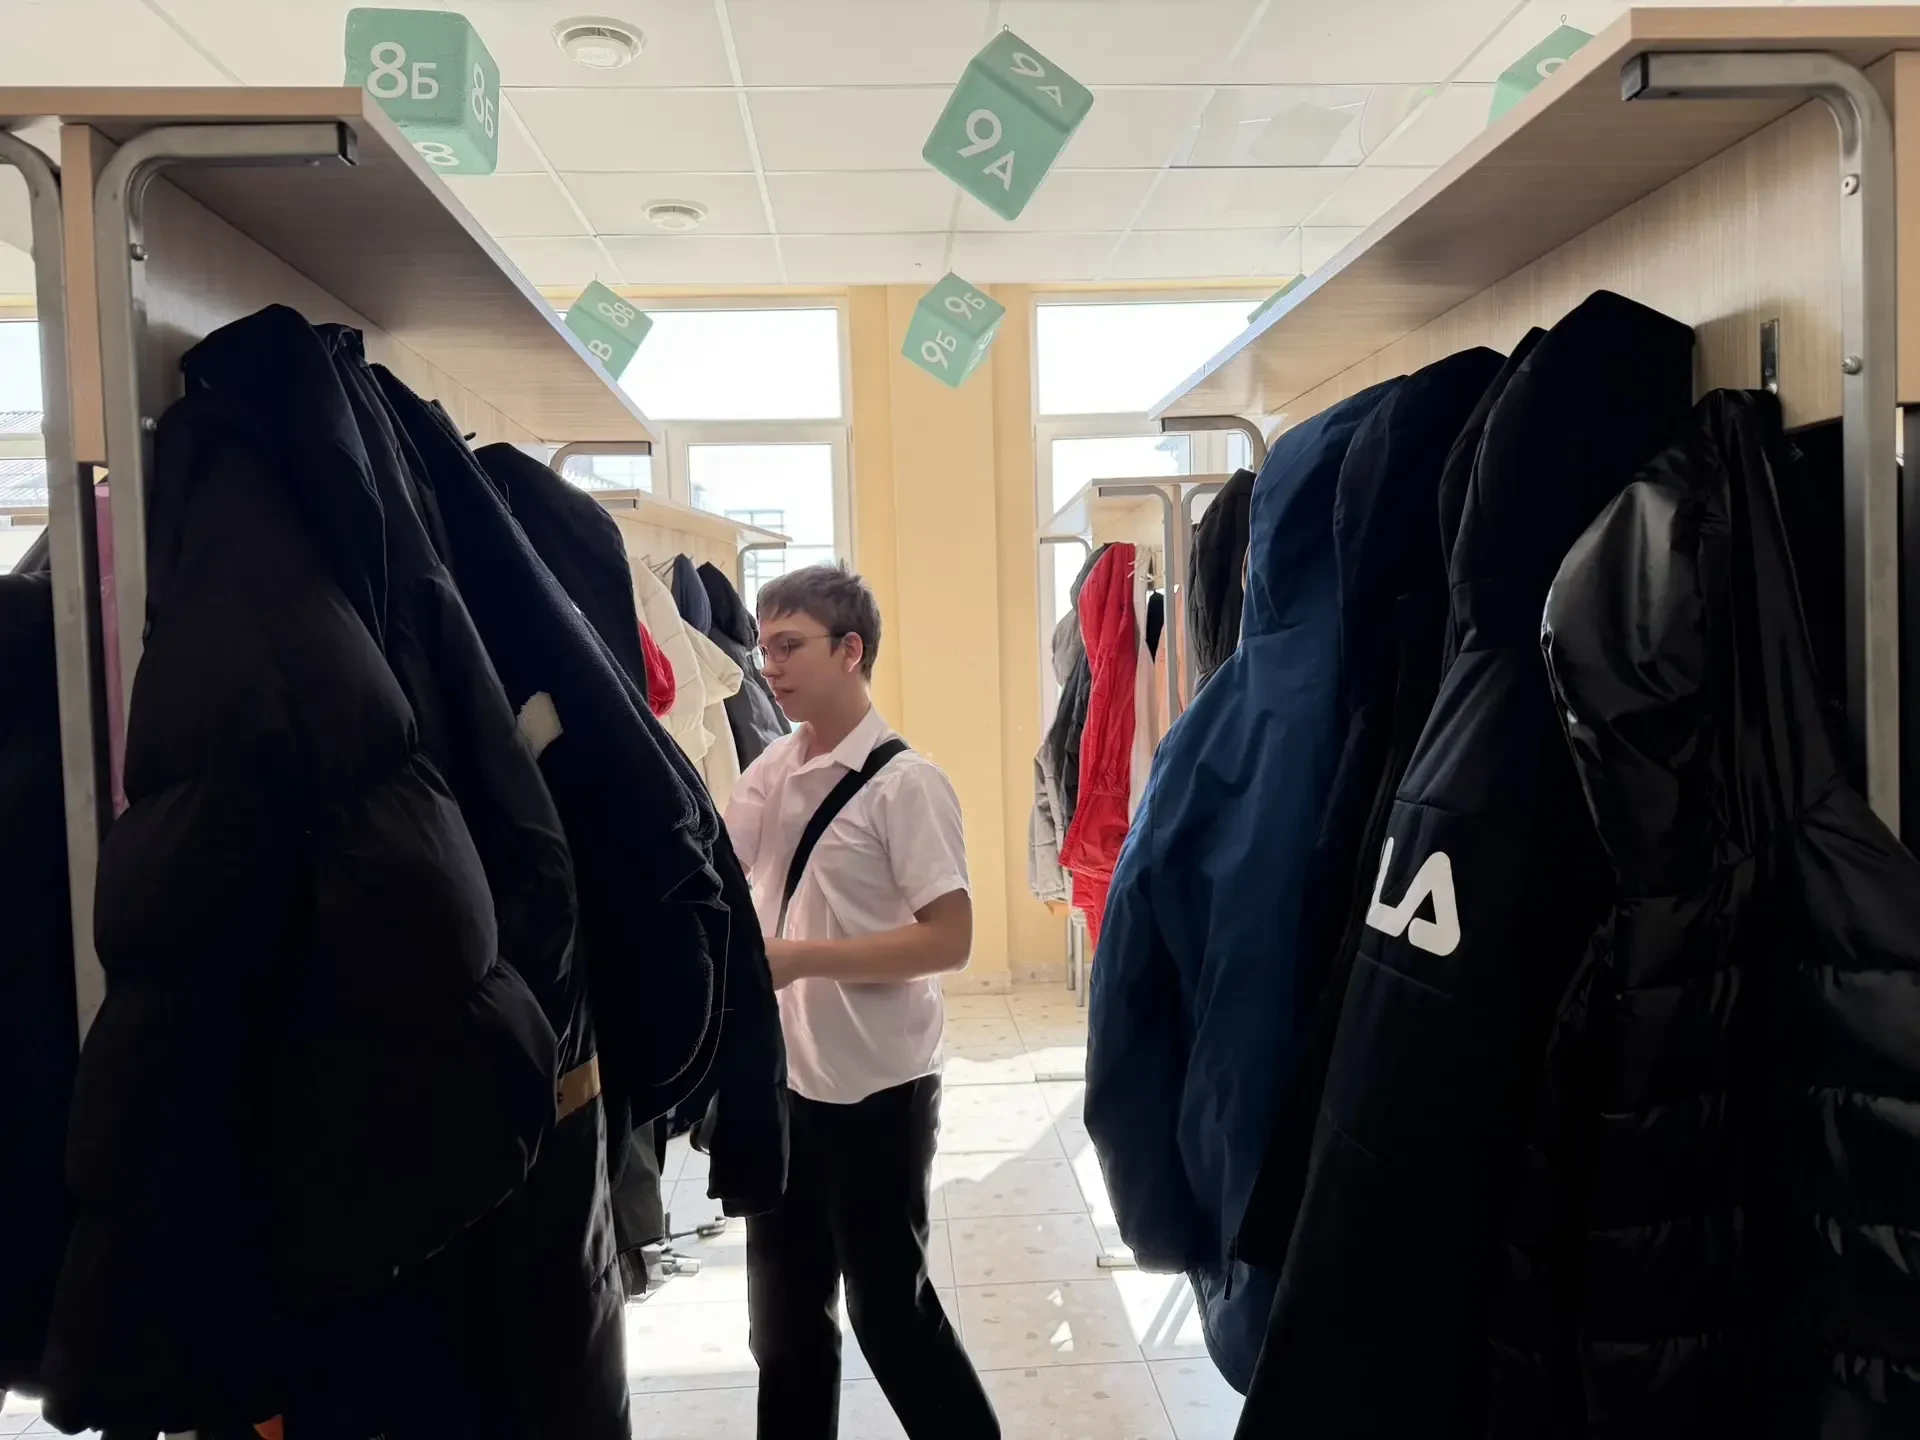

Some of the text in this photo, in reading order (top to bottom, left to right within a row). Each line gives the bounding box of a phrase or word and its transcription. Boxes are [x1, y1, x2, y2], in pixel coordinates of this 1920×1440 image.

[366, 41, 439, 100] 8Б
[1009, 52, 1064, 107] 9А
[471, 62, 495, 139] 8Б
[956, 108, 1015, 191] 9А
[597, 302, 635, 328] 8В
[944, 292, 987, 320] 9Б
[920, 328, 957, 371] 9Б
